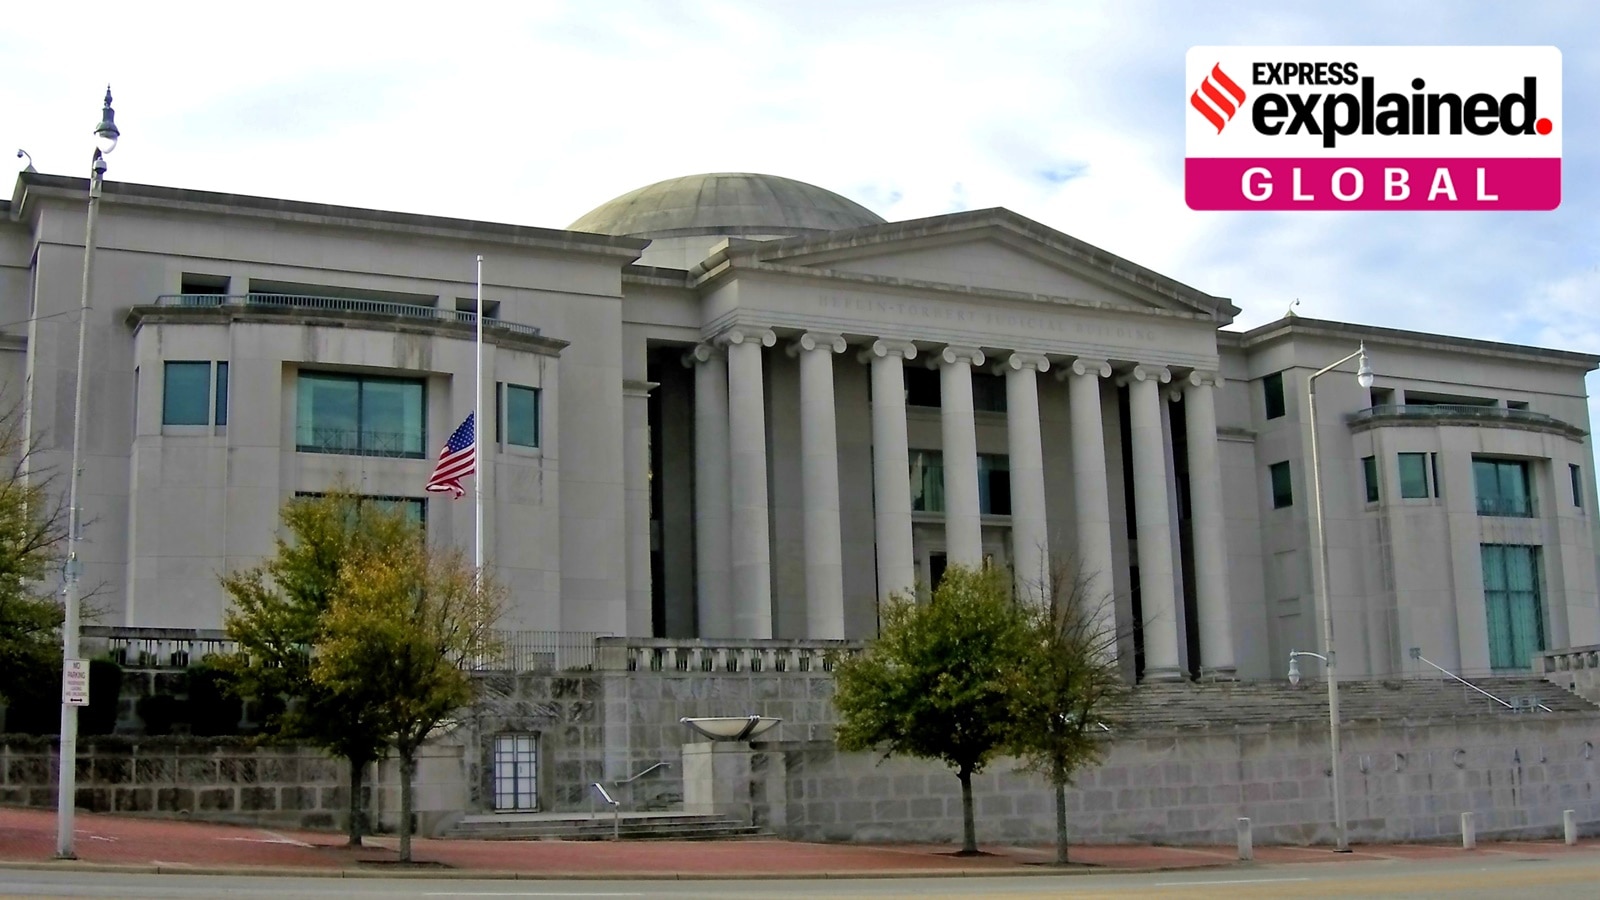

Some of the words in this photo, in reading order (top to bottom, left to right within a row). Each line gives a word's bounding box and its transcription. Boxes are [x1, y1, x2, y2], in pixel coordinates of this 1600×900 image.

[985, 313, 1065, 333] JUDICIAL
[1075, 322, 1156, 342] BUILDING
[67, 671, 86, 679] PARKING
[1323, 747, 1548, 777] UDICAL
